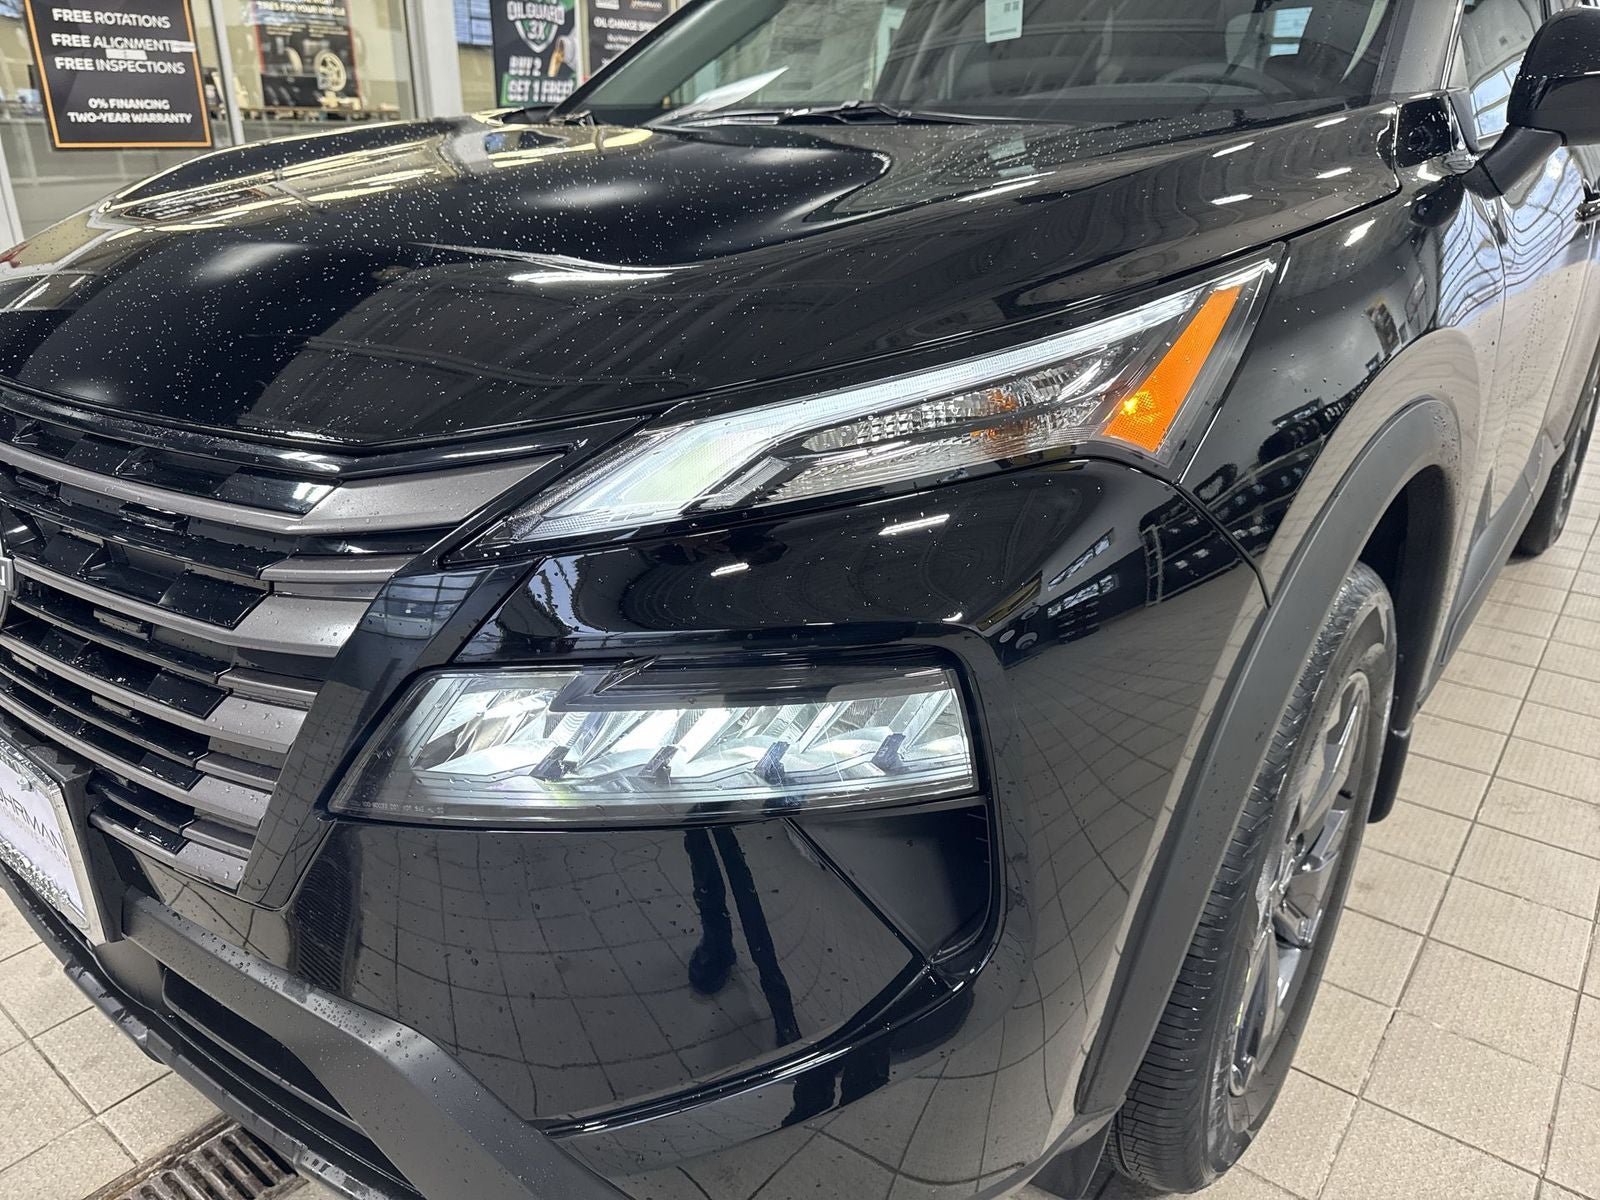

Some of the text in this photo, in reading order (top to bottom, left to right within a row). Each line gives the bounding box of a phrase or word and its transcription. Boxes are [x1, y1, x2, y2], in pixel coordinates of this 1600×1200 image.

[52, 8, 171, 28] FREE ROTATIONS
[593, 16, 607, 28] OIL
[527, 21, 547, 40] 3X
[51, 33, 92, 48] FREE
[54, 57, 186, 75] FREE INSPECTIONS
[509, 55, 542, 76] BUY 2
[508, 80, 531, 102] GET
[533, 80, 540, 102] 1
[88, 98, 171, 110] 0% FINANCING
[67, 111, 193, 123] TWO-YEAR WARRANTY
